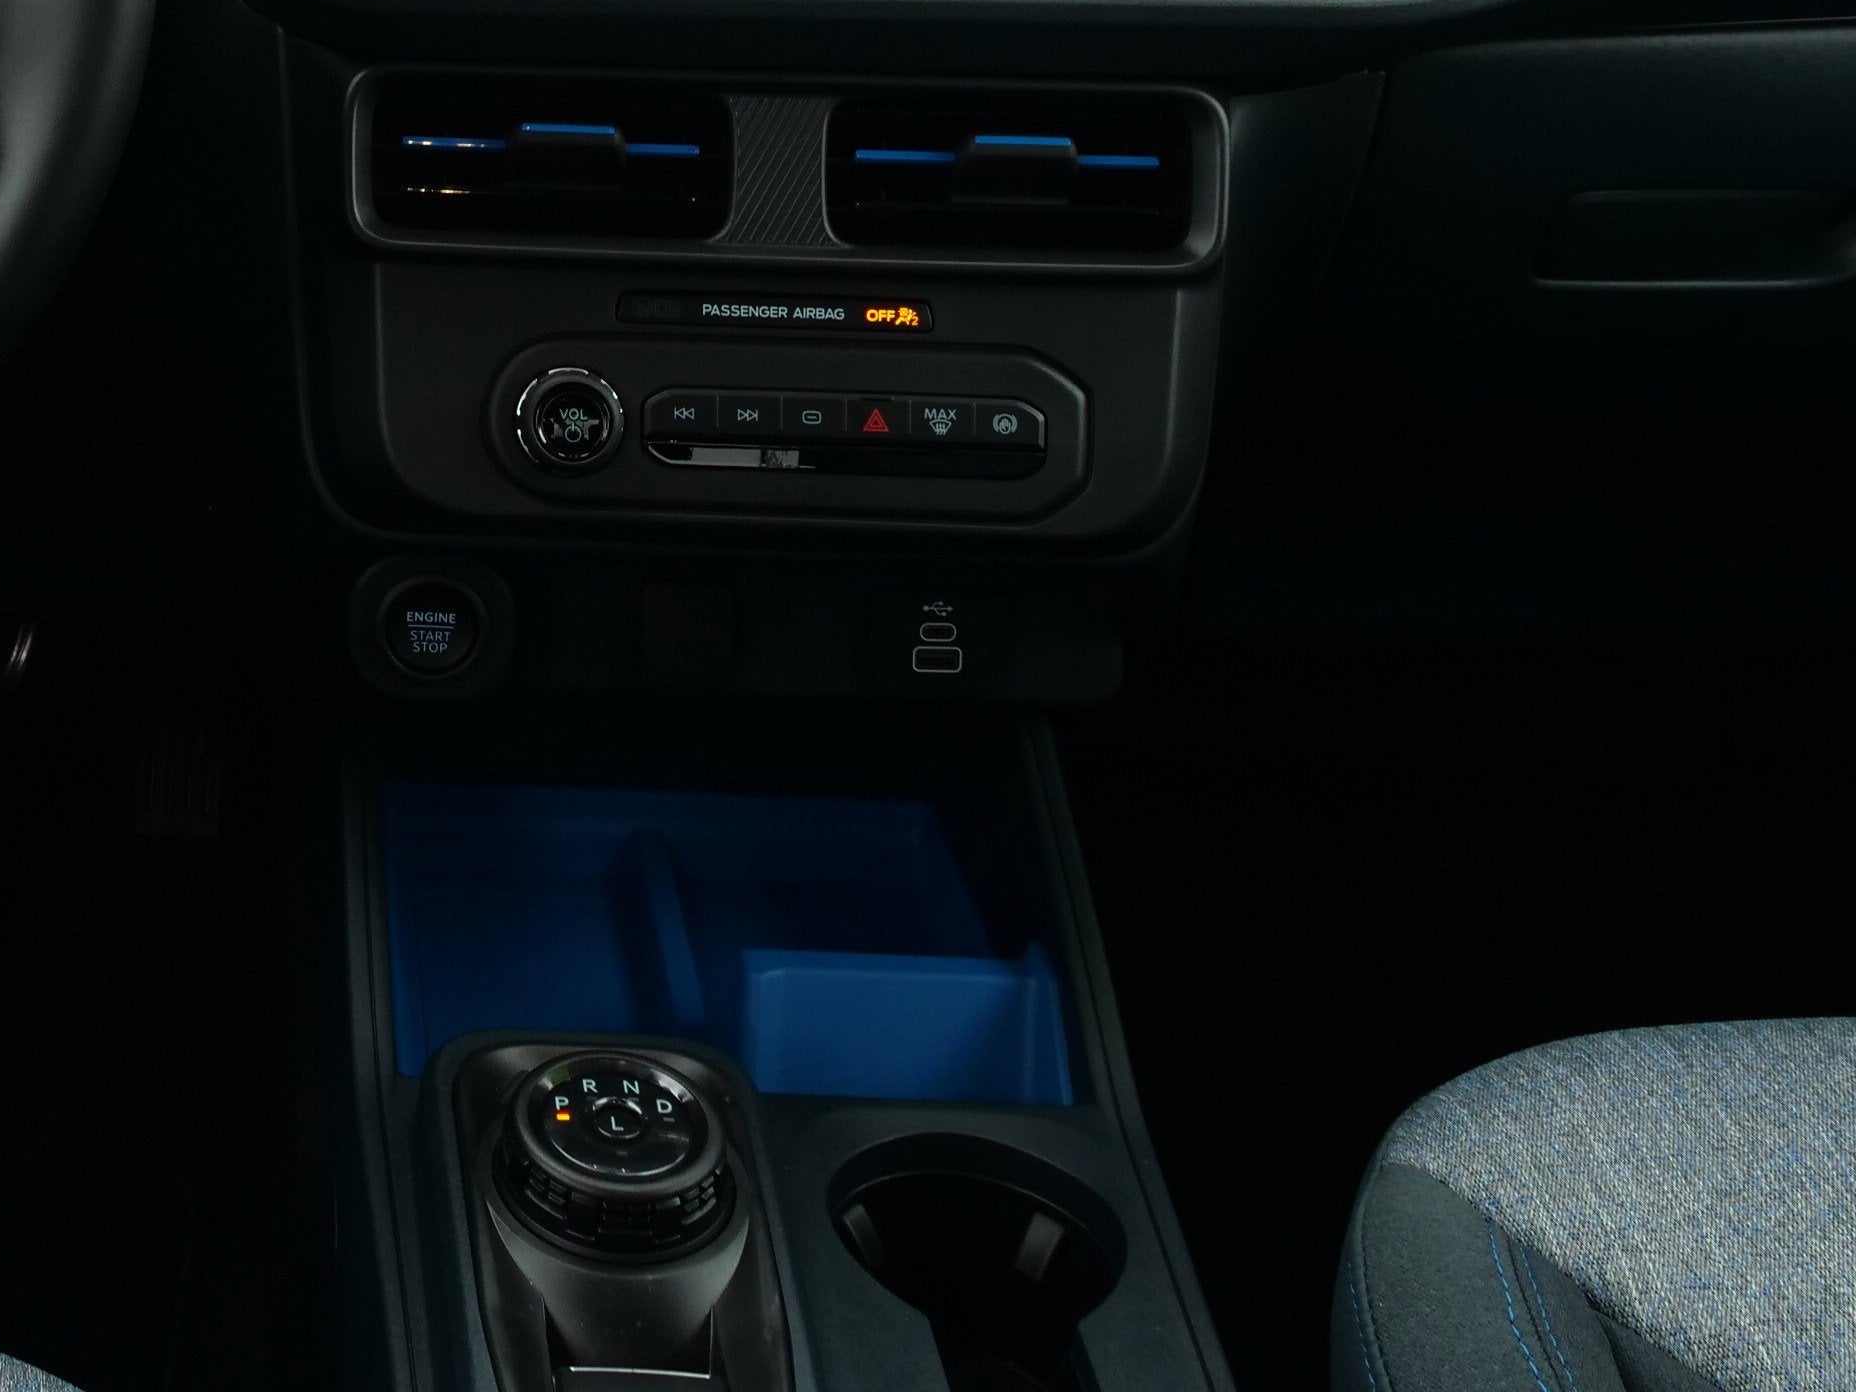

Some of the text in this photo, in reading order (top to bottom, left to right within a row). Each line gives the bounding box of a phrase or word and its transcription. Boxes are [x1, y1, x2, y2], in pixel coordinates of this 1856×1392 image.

[702, 303, 788, 319] PASSENGER
[792, 306, 845, 321] AIRBAG
[865, 307, 896, 323] OFF
[558, 407, 589, 421] VOL
[923, 408, 957, 421] MAX
[406, 611, 457, 625] ENGINE
[410, 630, 452, 642] START
[412, 642, 448, 653] STOP
[554, 1078, 673, 1114] P R N D
[610, 1115, 624, 1132] L
